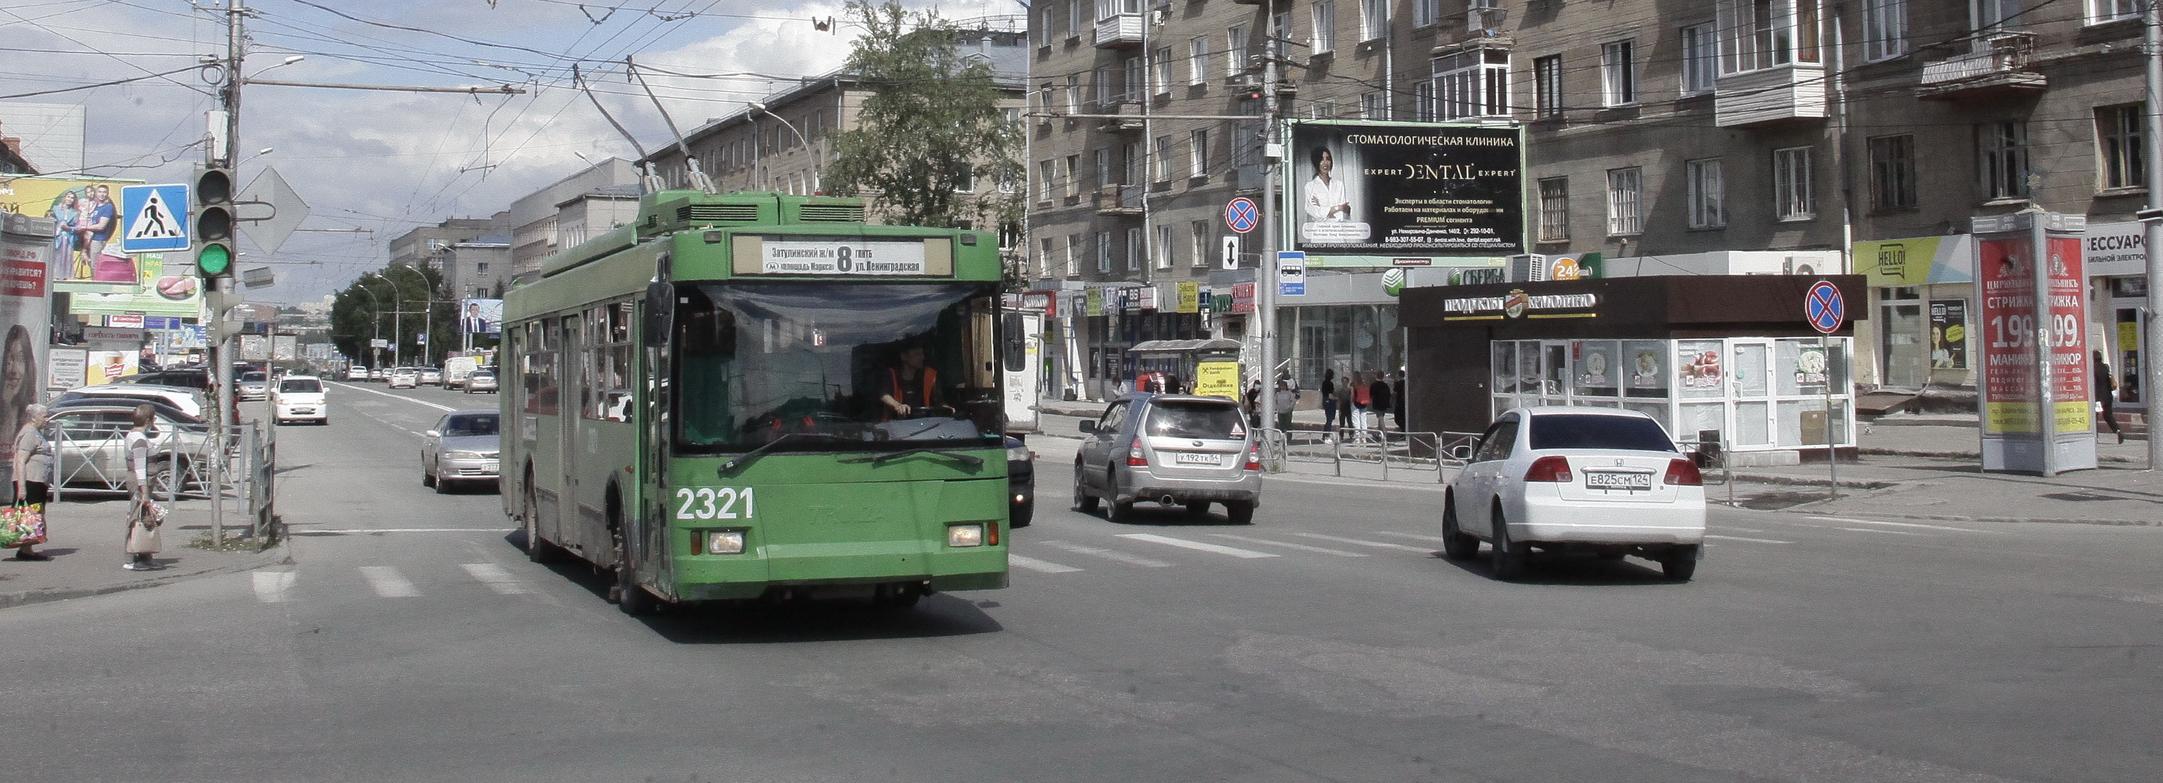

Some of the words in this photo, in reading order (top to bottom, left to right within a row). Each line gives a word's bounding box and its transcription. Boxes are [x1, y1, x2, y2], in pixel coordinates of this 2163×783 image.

[1347, 134, 1463, 146] СТОМАТОЛОГИЧЕСКАЯ
[1465, 136, 1514, 147] КЛИНИКА
[771, 247, 819, 259] Затулинский
[837, 246, 853, 272] 8
[1878, 250, 1906, 267] HELLO!
[855, 262, 865, 272] ул.
[866, 261, 920, 272] Ленинградская
[1557, 265, 1574, 277] 24
[1591, 474, 1632, 485] Е825СМ
[1633, 474, 1649, 483] 124
[676, 487, 753, 520] 2321
